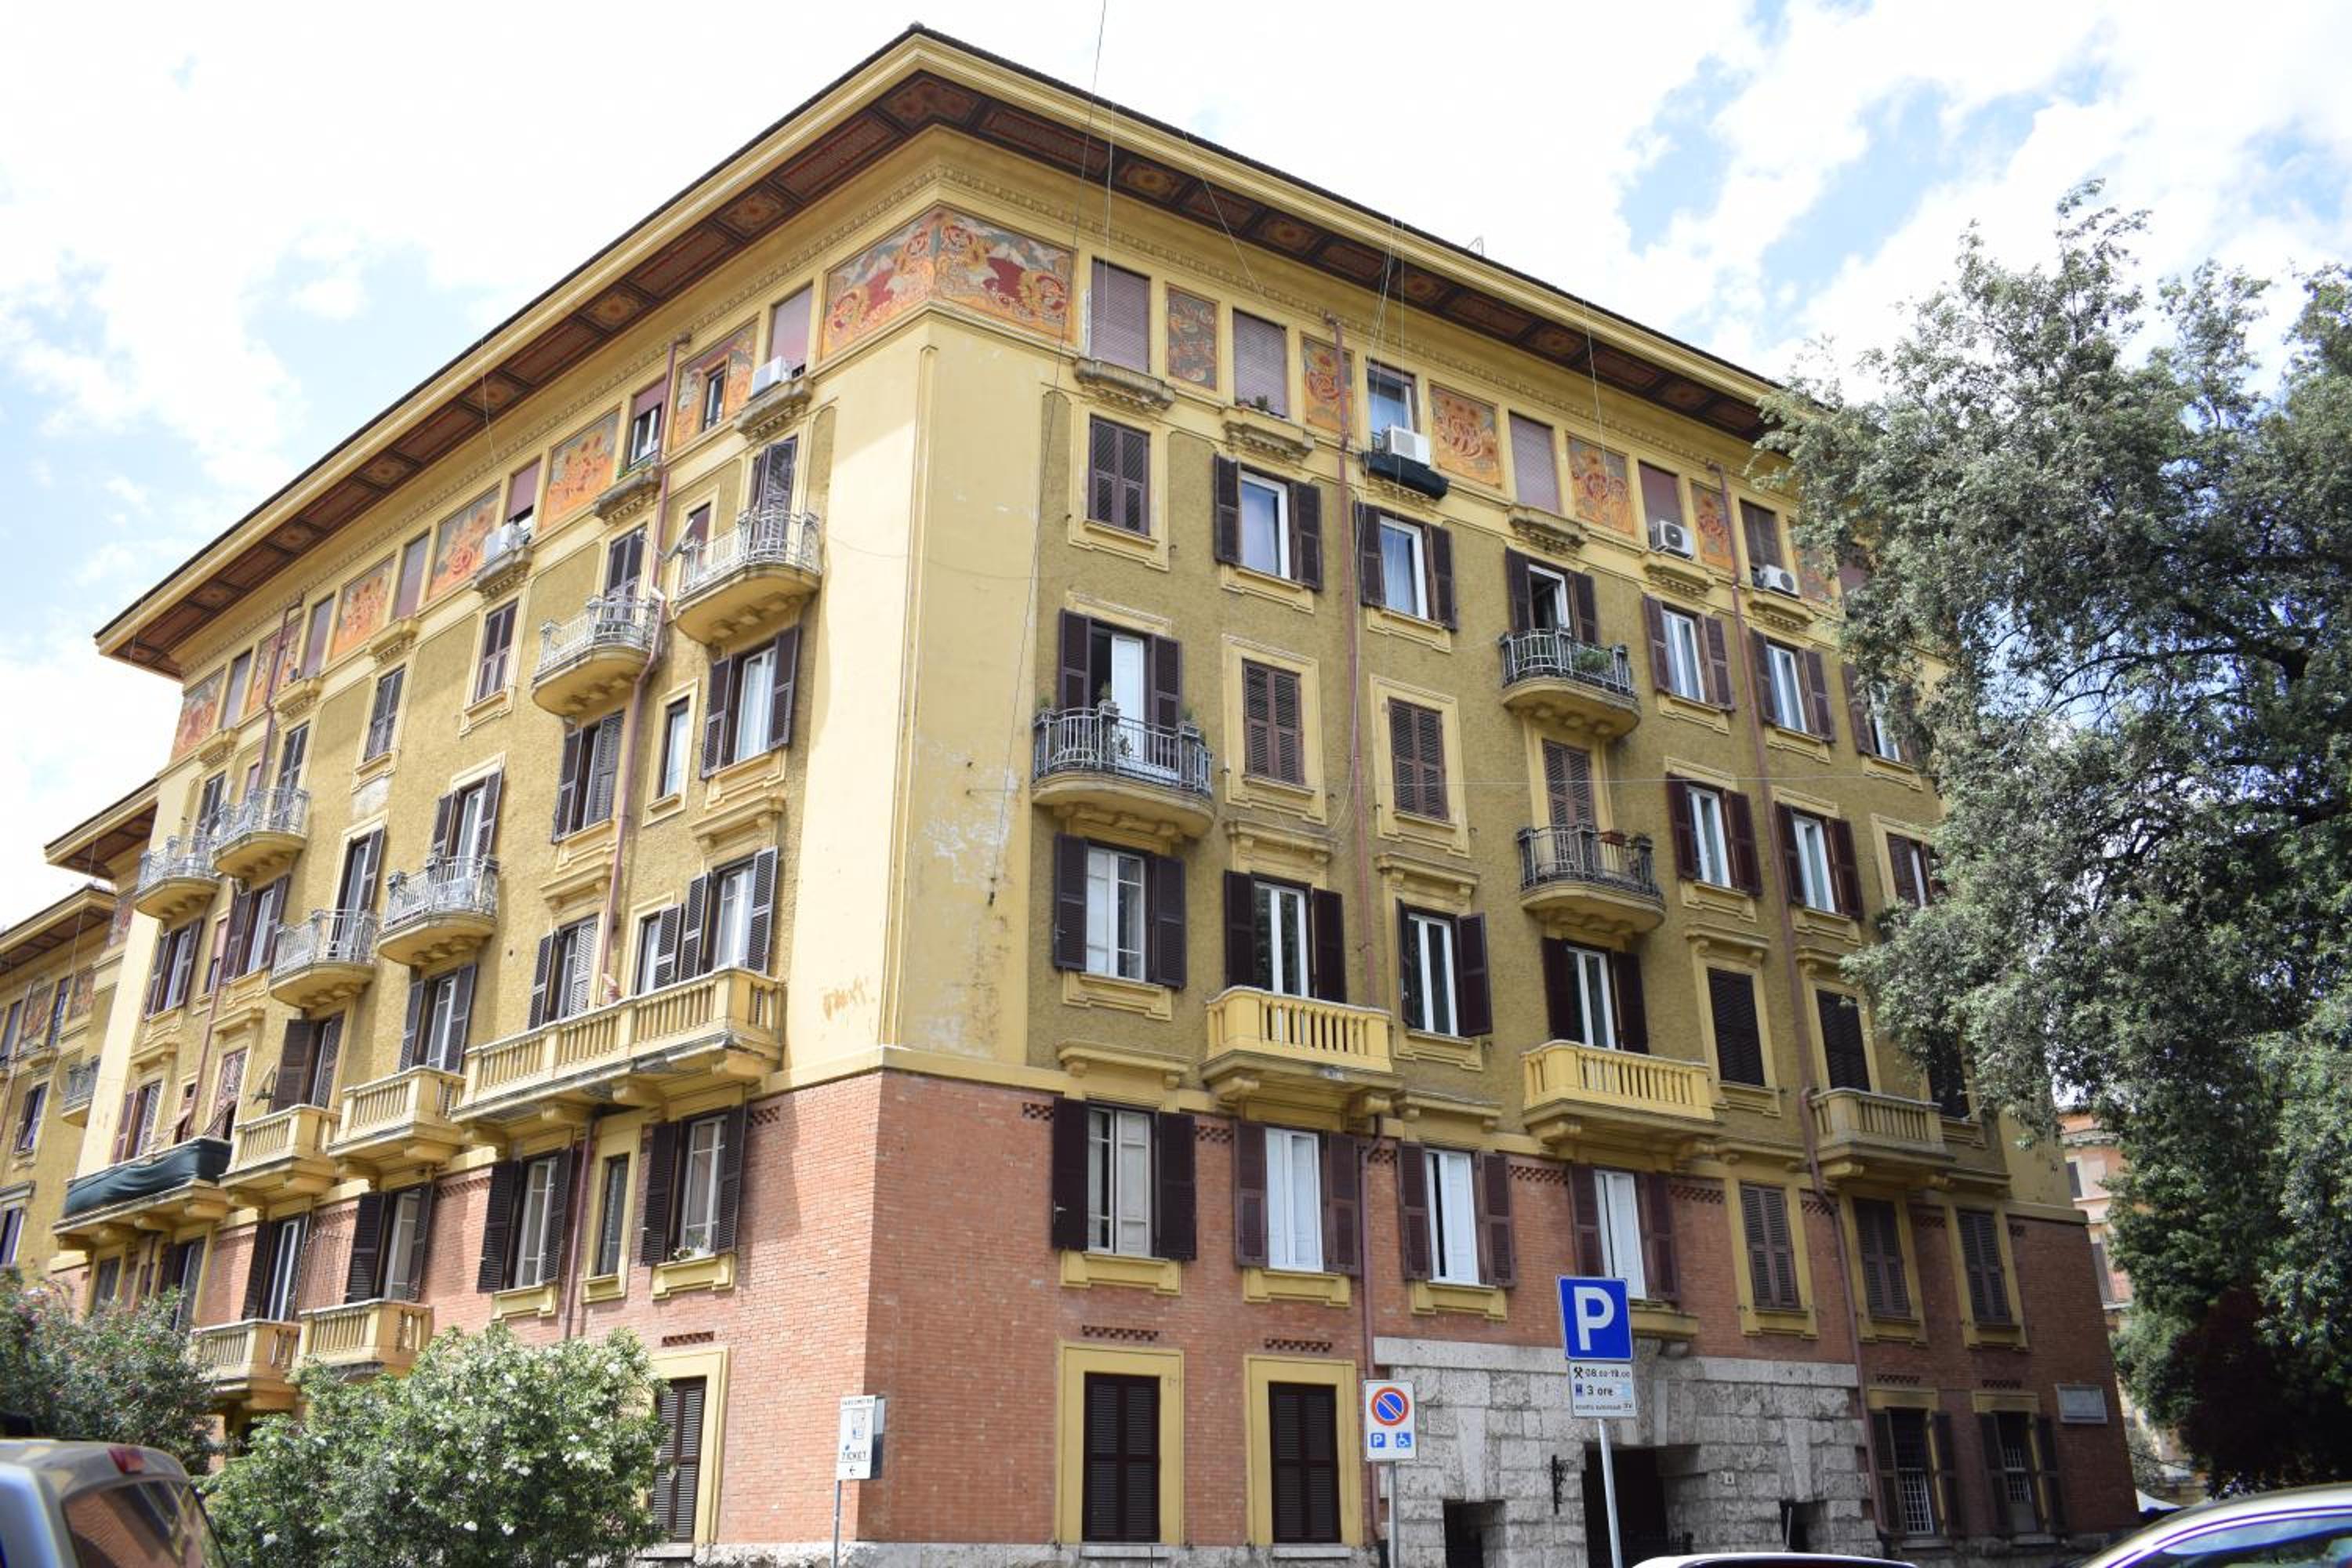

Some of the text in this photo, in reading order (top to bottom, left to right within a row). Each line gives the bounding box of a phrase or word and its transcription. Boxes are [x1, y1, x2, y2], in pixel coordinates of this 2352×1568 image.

[1573, 1286, 1614, 1351] P
[1587, 1384, 1614, 1396] 3 ore
[1373, 1434, 1383, 1446] P
[841, 1451, 866, 1461] TICKET
